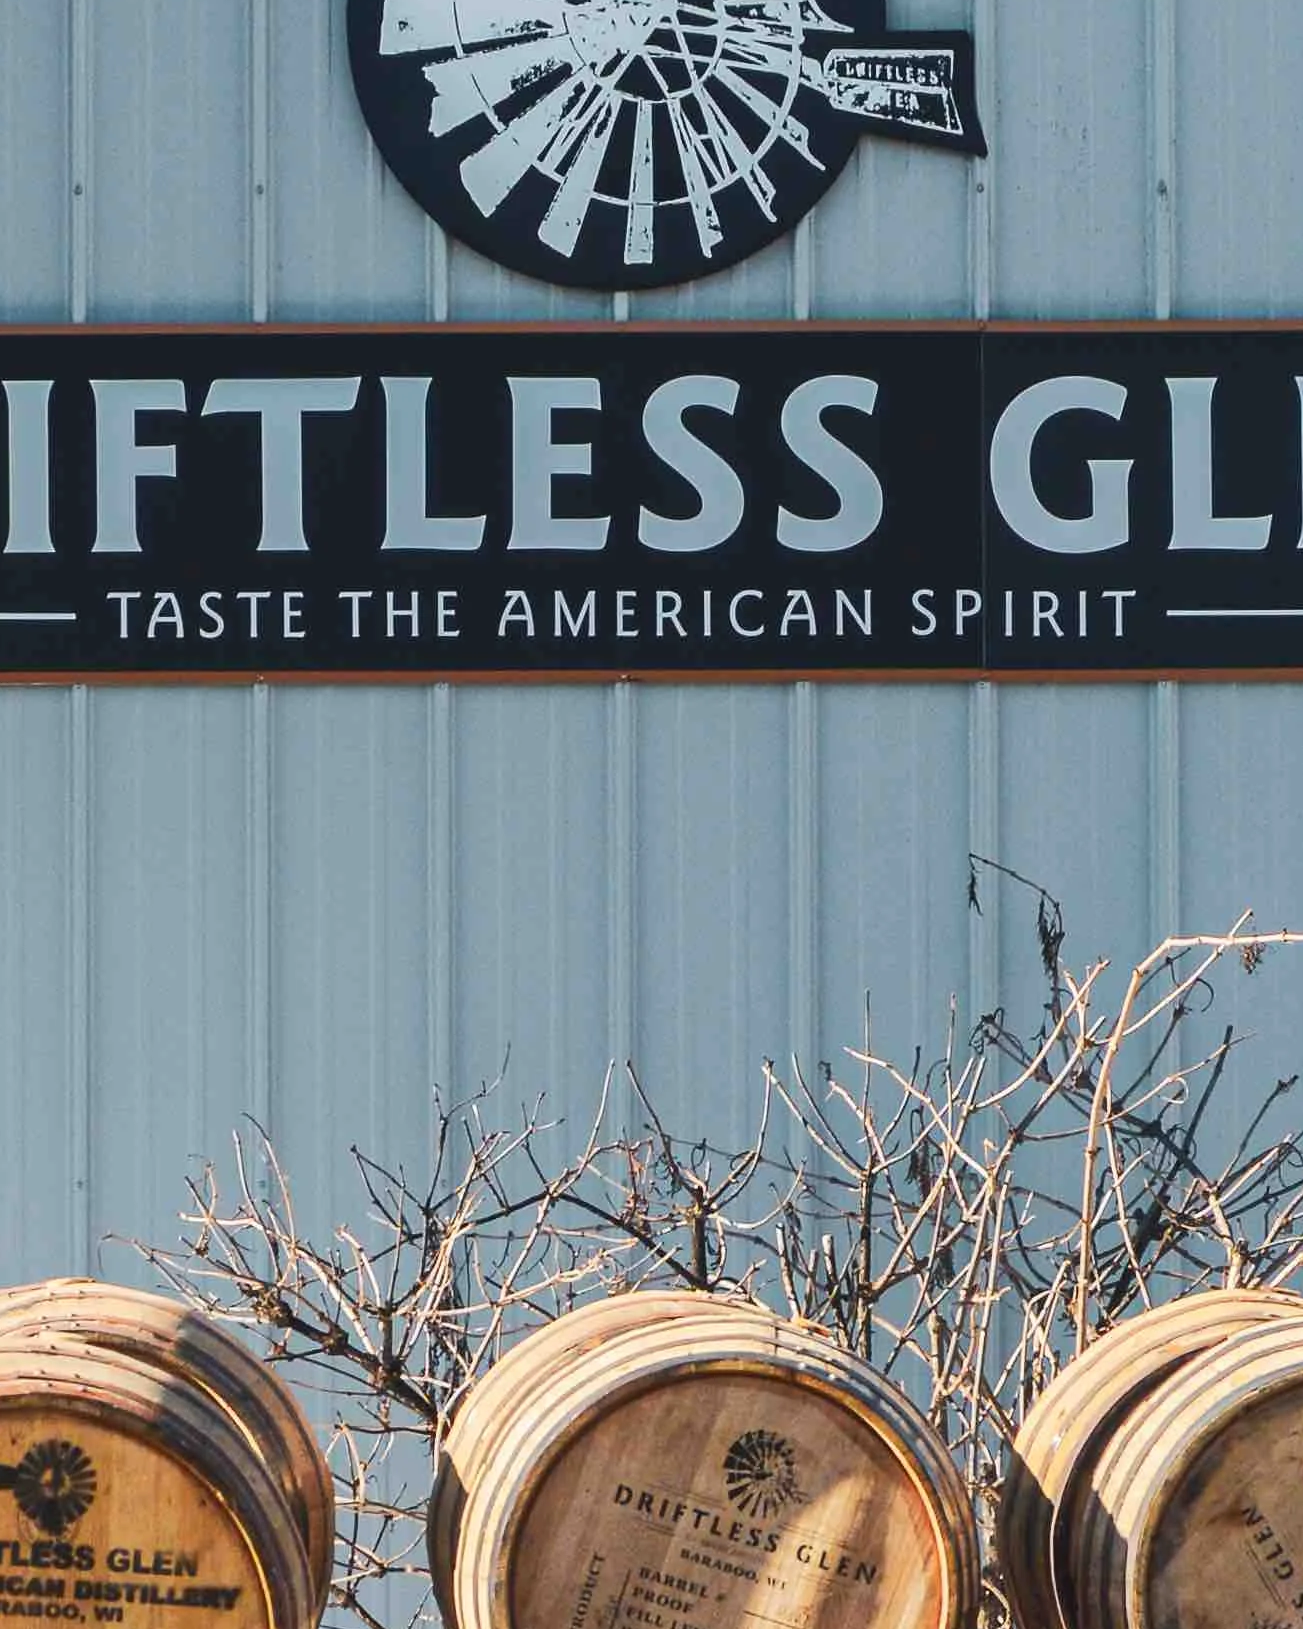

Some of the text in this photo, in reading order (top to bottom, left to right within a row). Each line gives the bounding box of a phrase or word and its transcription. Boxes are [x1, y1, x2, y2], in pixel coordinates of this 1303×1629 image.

[107, 587, 1137, 639] TASTE THE AMERICAN SPIRIT
[613, 1484, 878, 1586] DRIFTLESS GLEN
[1243, 1507, 1294, 1580] GLEN
[107, 1548, 198, 1578] GLEN
[74, 1580, 243, 1610] DISTILLERY
[638, 1567, 709, 1599] BARREL
[94, 1605, 124, 1623] WI
[632, 1586, 694, 1614] PROOF
[625, 1605, 665, 1629] FILL
